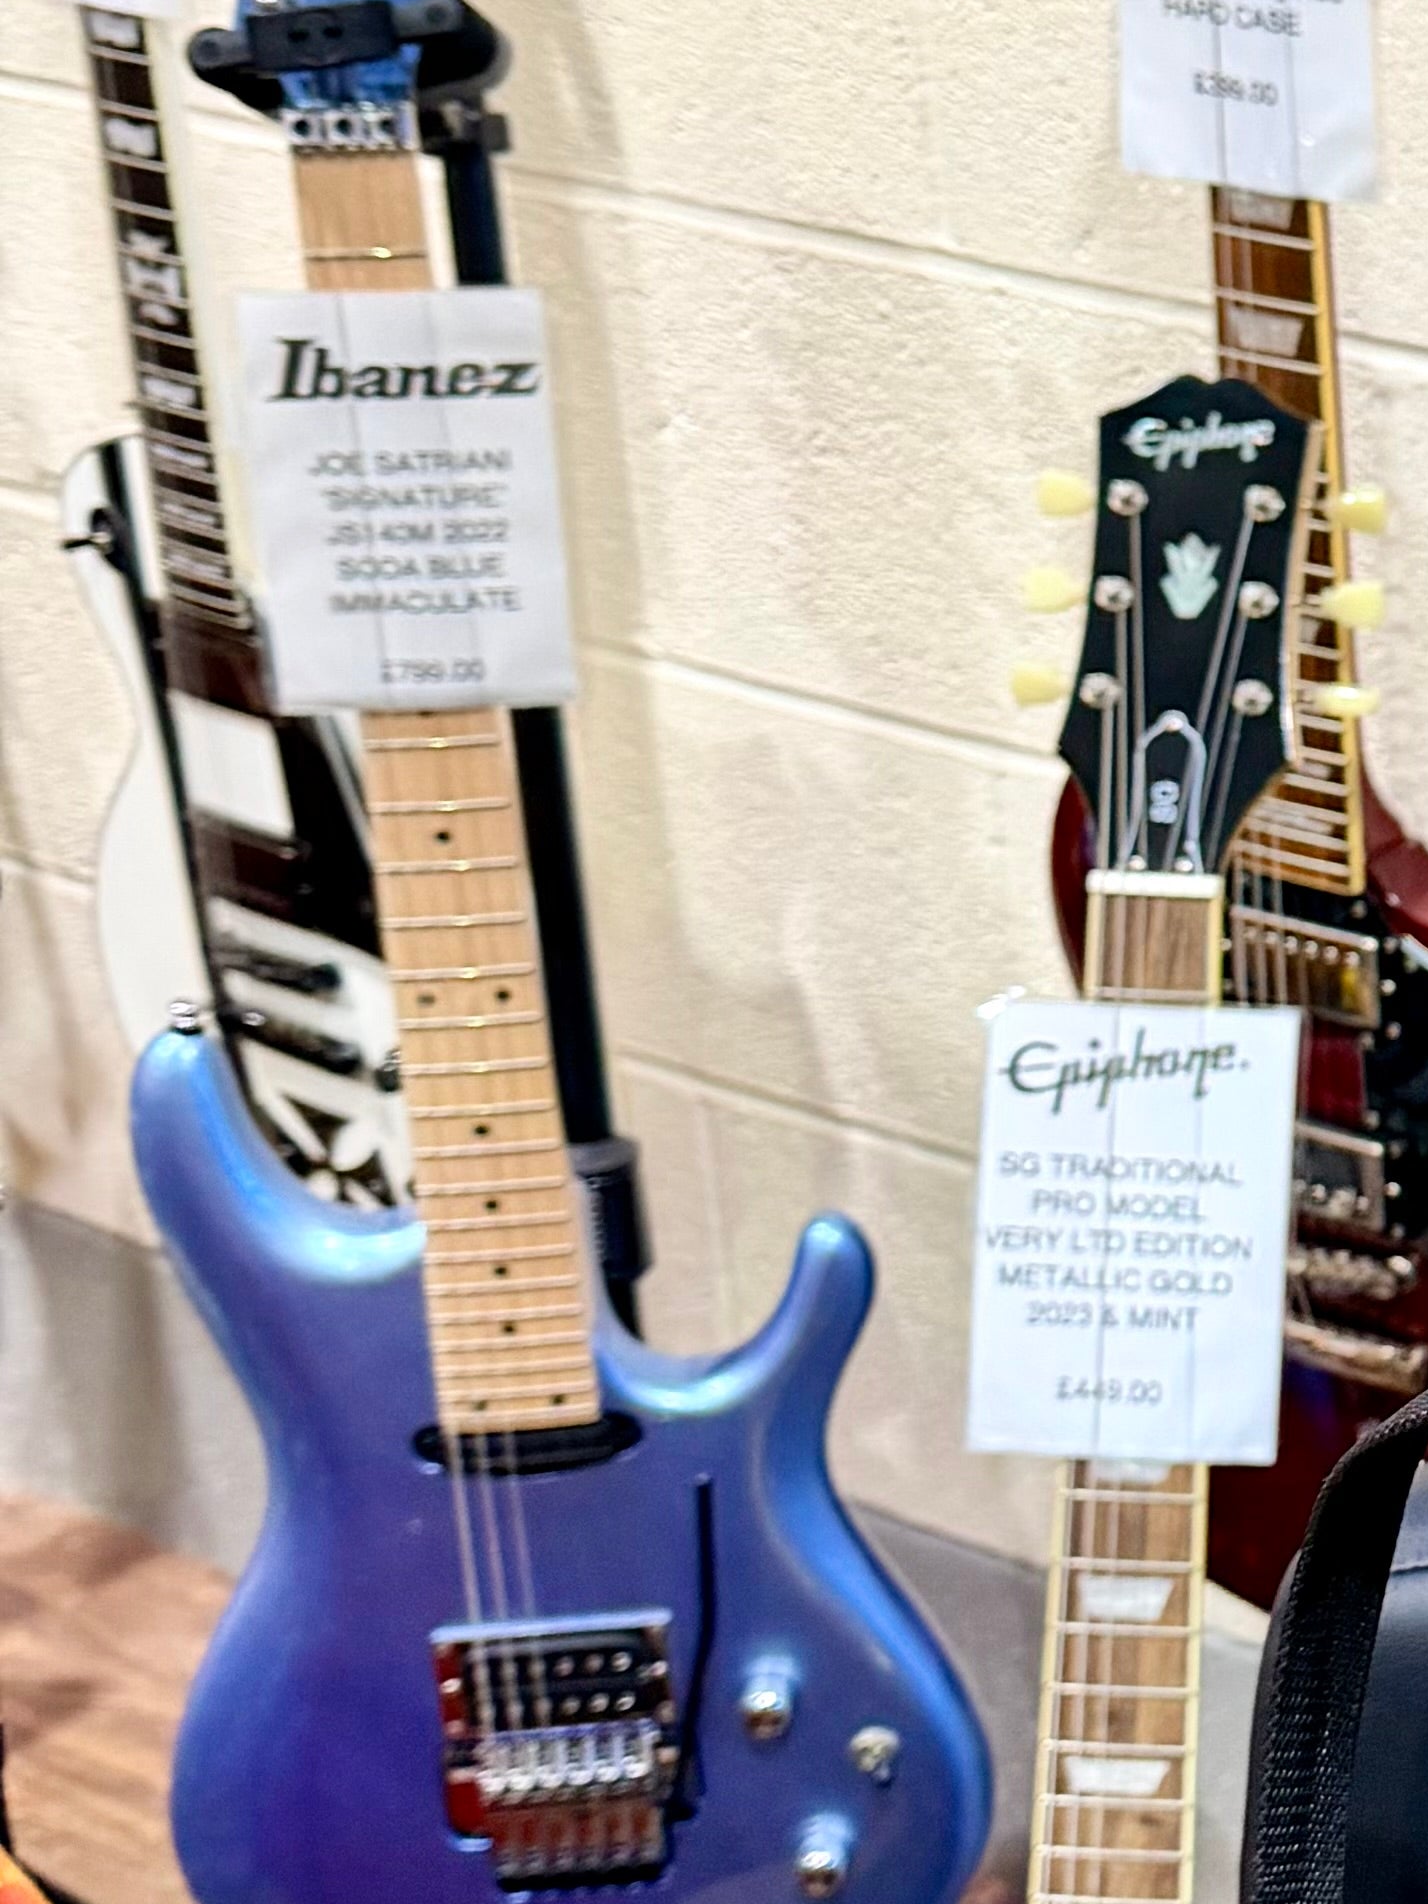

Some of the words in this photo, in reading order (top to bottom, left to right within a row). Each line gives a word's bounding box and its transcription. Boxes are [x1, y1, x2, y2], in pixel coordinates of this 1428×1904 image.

[1234, 5, 1302, 37] CASE
[266, 337, 541, 403] Ibanez
[1121, 410, 1276, 472] Epiphone
[309, 450, 363, 477] JOE
[374, 447, 513, 475] SATRIANI
[322, 483, 507, 511] SIGNATURE
[336, 555, 420, 581] SODA
[428, 552, 505, 579] BLUE
[327, 586, 523, 614] IMMACULATE
[1000, 1150, 1040, 1177] SG
[1049, 1152, 1243, 1186] TRADITIONAL
[1031, 1189, 1097, 1217] PRO
[1105, 1193, 1207, 1223] MODEL
[985, 1225, 1062, 1251] VERY
[1071, 1229, 1126, 1255] LTD
[1133, 1232, 1254, 1260] EDITION
[998, 1263, 1141, 1293] METALLIC
[1149, 1268, 1234, 1297] GOLD
[1101, 1302, 1120, 1328] &
[1128, 1304, 1199, 1333] MINT
